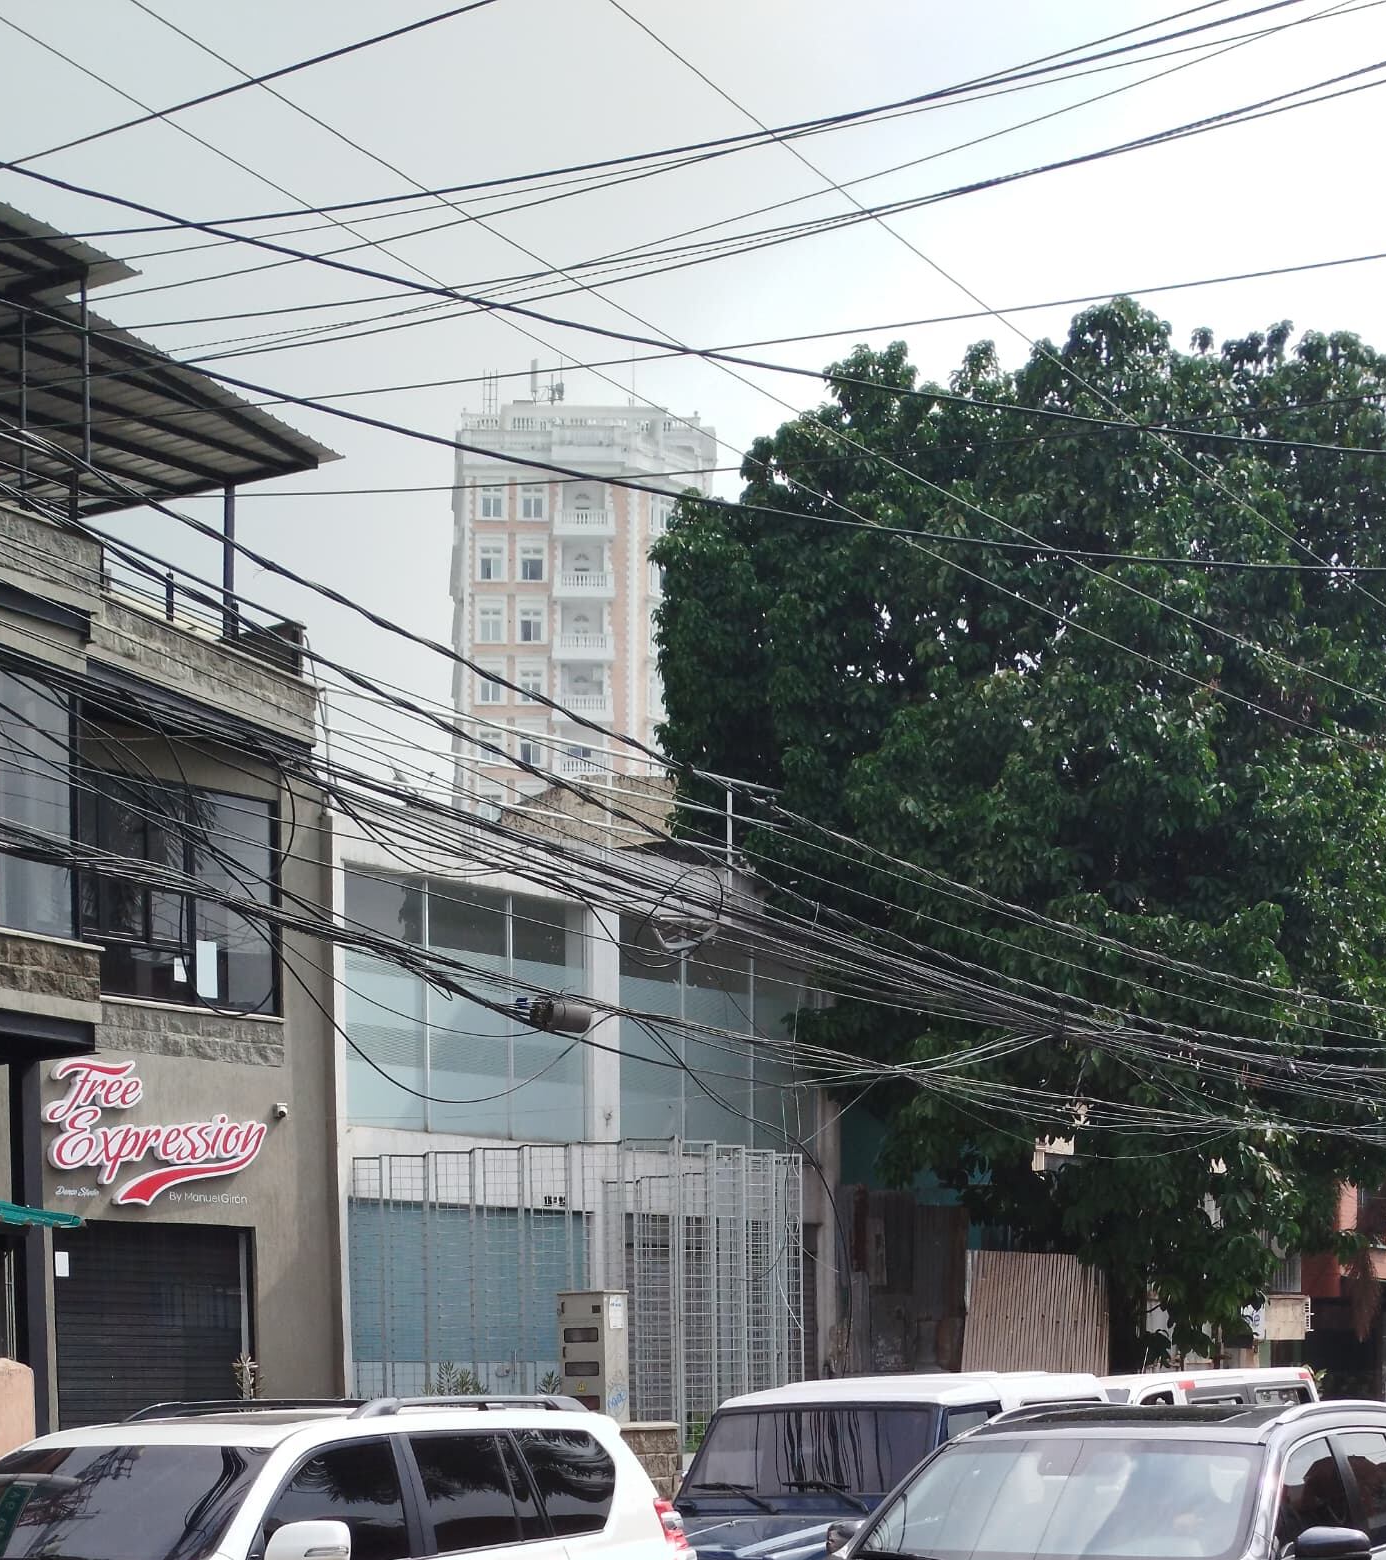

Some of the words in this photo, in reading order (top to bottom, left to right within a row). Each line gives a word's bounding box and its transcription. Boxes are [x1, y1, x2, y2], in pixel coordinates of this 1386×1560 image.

[43, 1058, 142, 1122] Free
[48, 1106, 267, 1184] Expression
[169, 1191, 182, 1204] By
